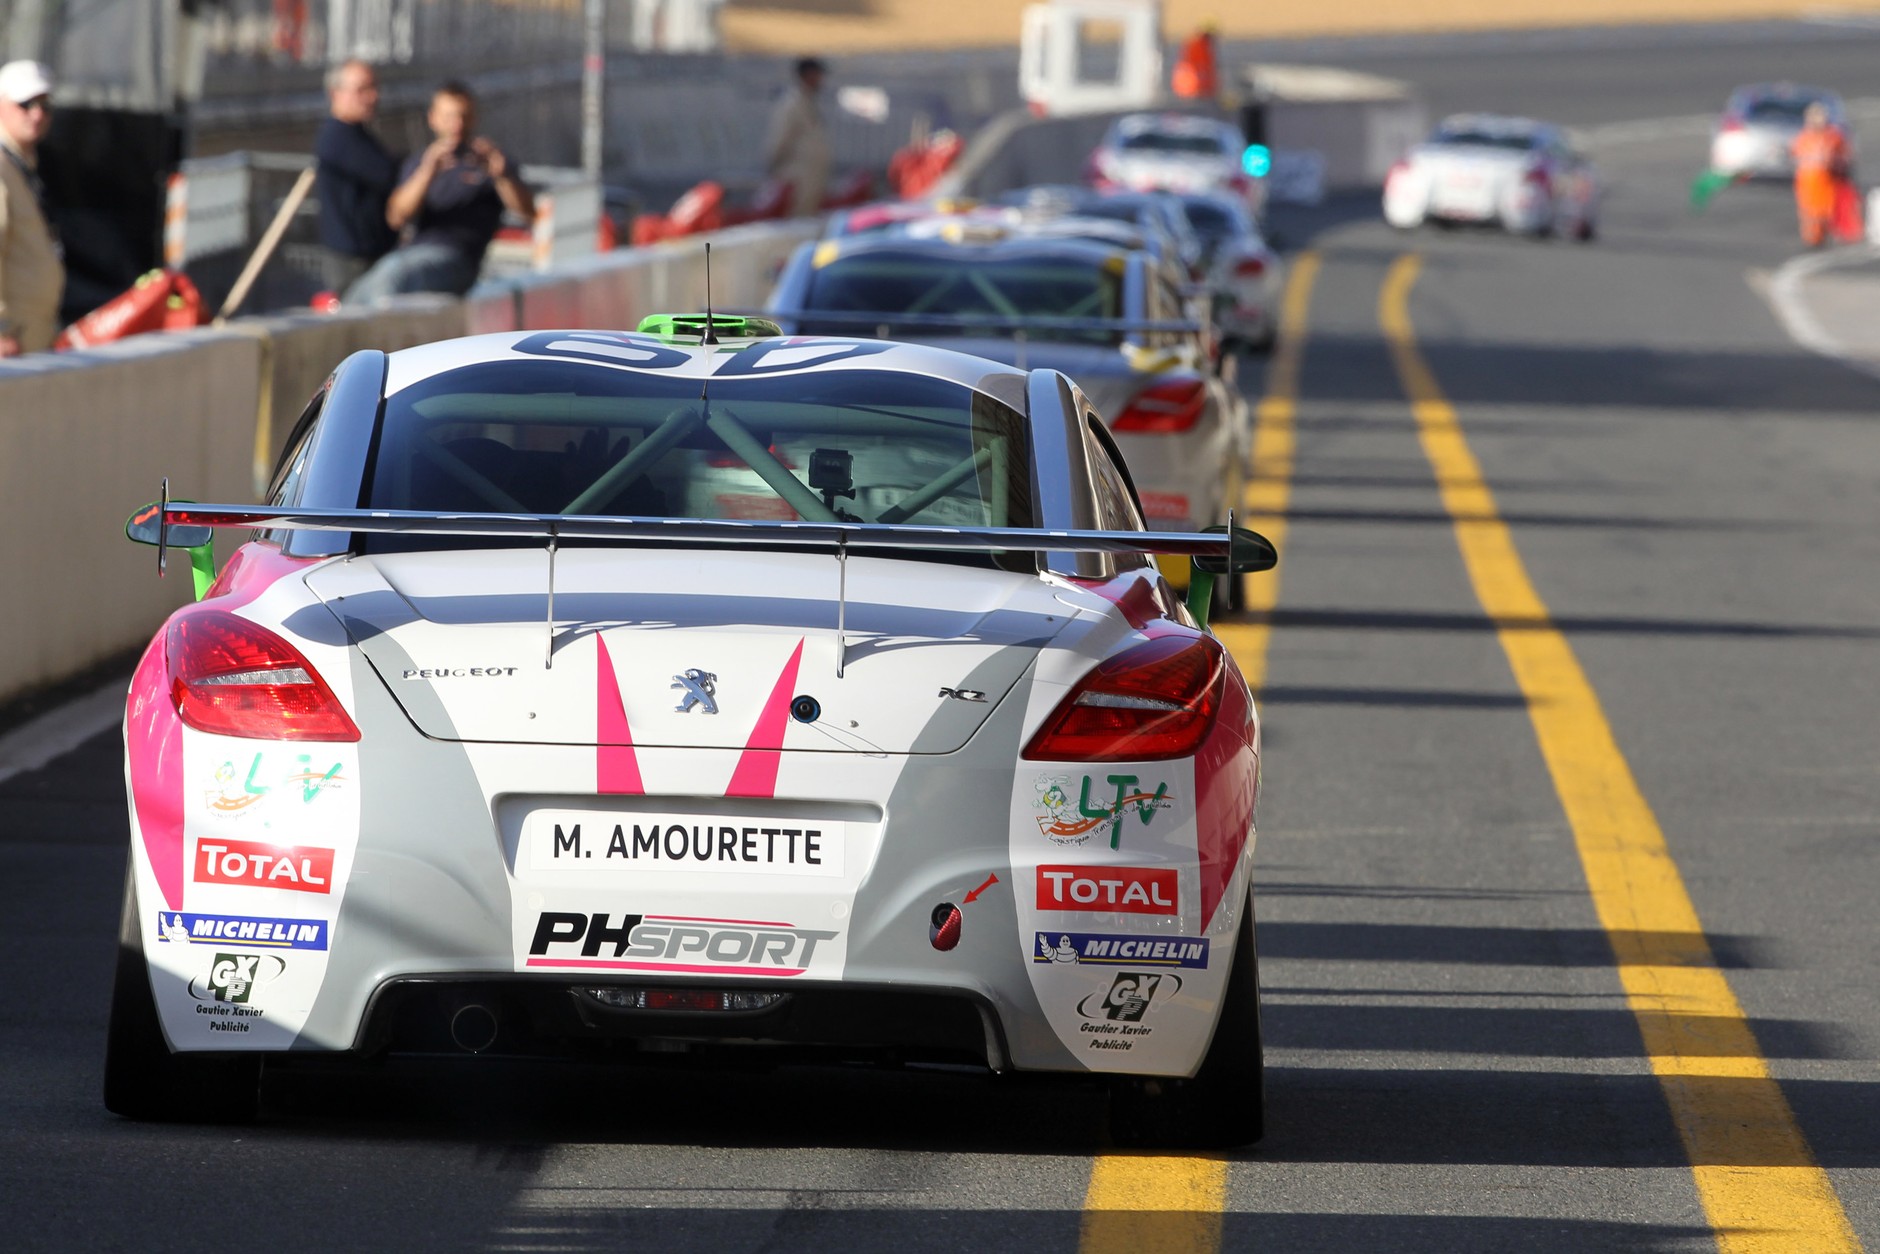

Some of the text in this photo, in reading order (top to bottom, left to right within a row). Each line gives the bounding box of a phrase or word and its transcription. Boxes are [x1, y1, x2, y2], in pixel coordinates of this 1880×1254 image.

[403, 667, 519, 679] PEUGEOT
[1079, 774, 1168, 850] LTV
[553, 824, 822, 865] M. AMOURETTE
[201, 844, 325, 886] TOTAL
[1043, 871, 1173, 907] TOTAL
[192, 919, 320, 942] MICHELIN
[1084, 940, 1204, 960] MICHELIN
[196, 1004, 264, 1017] Gautier Xavier
[210, 1021, 250, 1032] Publicité
[1080, 1022, 1152, 1036] Gautier Xavier
[1089, 1039, 1133, 1051] Publicité
